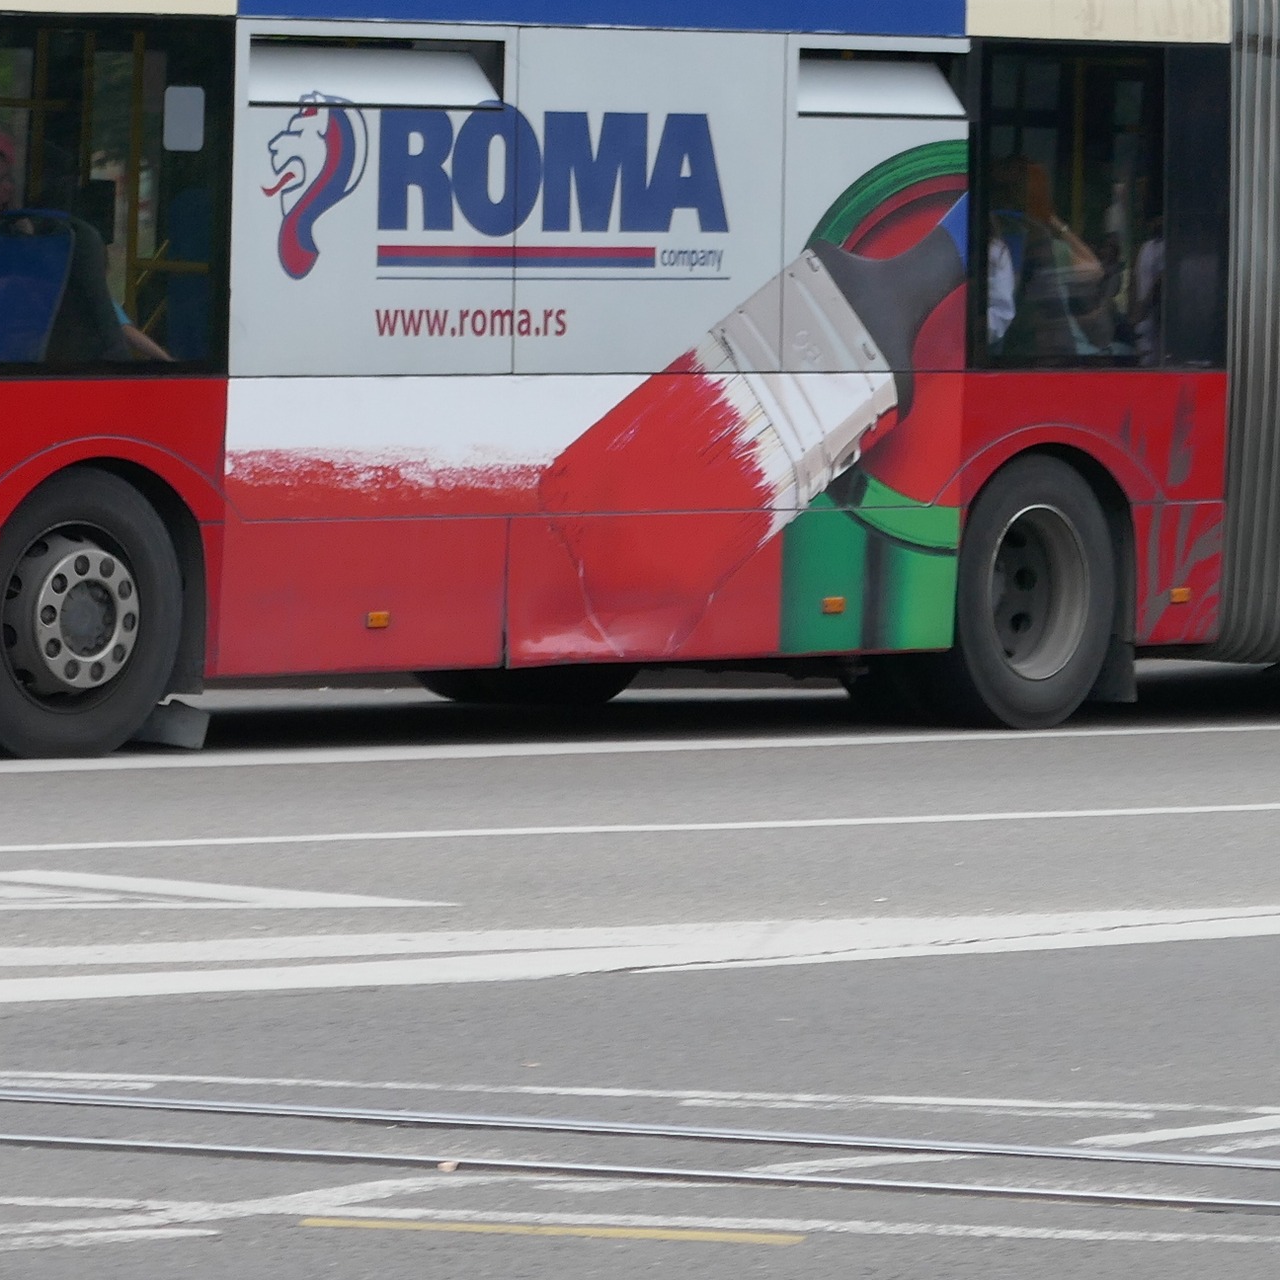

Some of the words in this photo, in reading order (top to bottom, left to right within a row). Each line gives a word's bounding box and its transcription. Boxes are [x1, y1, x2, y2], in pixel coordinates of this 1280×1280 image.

[376, 100, 729, 237] ROMA
[660, 245, 723, 273] company
[375, 304, 568, 338] www.roma.rs
